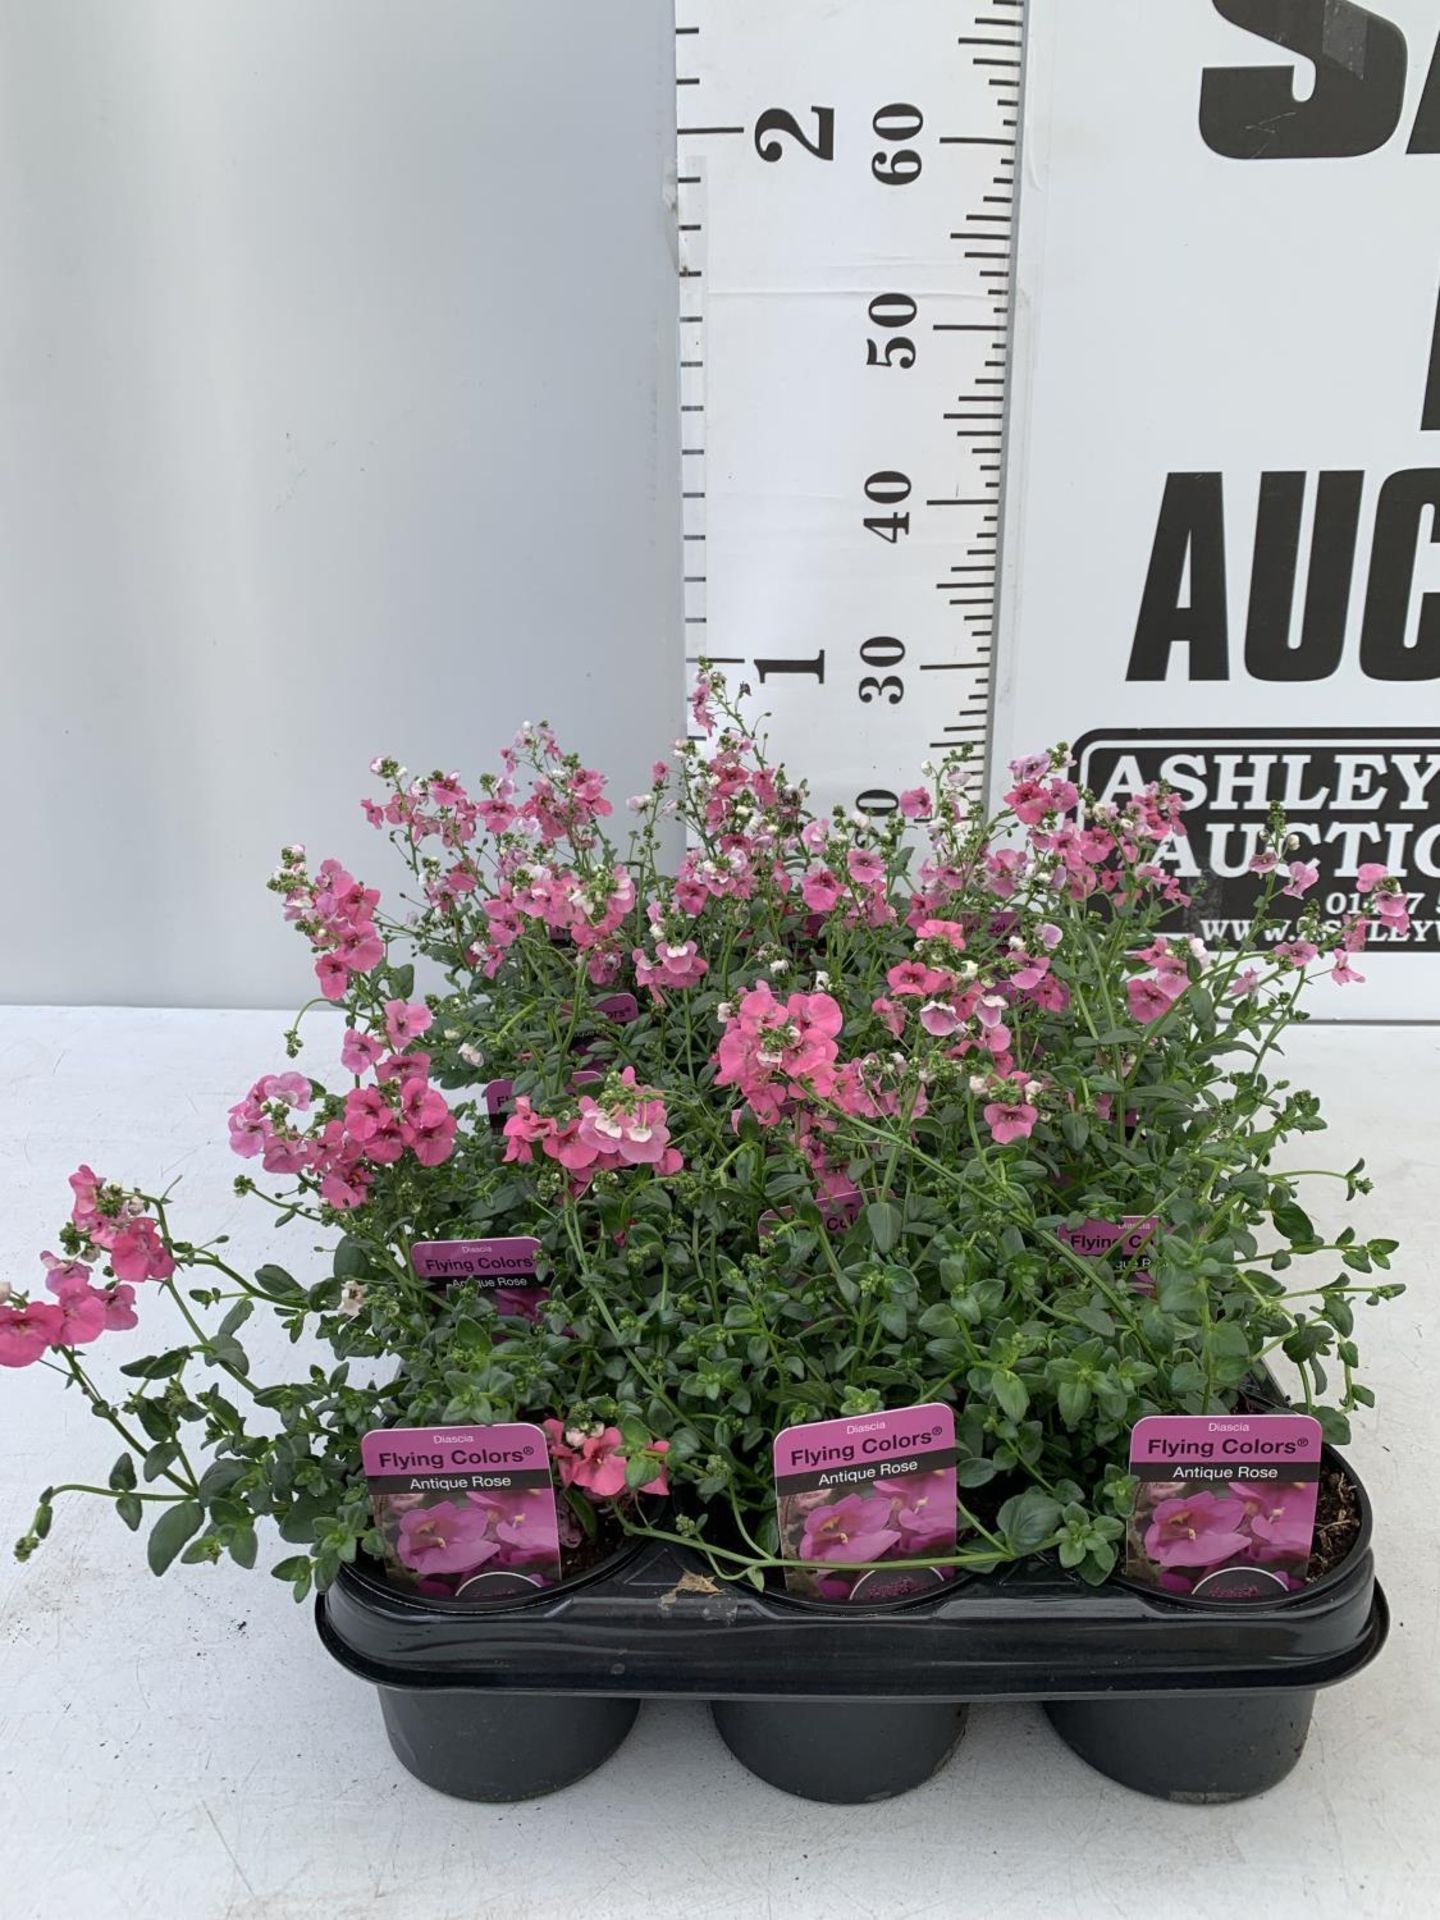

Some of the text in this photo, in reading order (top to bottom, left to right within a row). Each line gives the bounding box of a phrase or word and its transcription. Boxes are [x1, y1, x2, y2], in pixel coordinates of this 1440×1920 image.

[1199, 0, 1440, 159] S
[754, 105, 834, 162] 2
[871, 103, 923, 186] 60
[866, 292, 917, 369] 50
[863, 470, 912, 544] 40
[753, 649, 825, 684] 1
[858, 636, 906, 705] 30
[1099, 754, 1440, 811] ASHLEY
[425, 1259, 475, 1273] Flying
[497, 1276, 528, 1287] Rose
[846, 1421, 886, 1434] Diascia
[1208, 1422, 1249, 1432] Diascia
[433, 1434, 475, 1444] Diascia
[1148, 1438, 1214, 1458] Flying
[379, 1451, 444, 1471] Flying
[791, 1444, 855, 1466] Flying
[410, 1475, 511, 1491] Antique Rose
[818, 1460, 918, 1486] Antique Rose
[1172, 1466, 1278, 1480] Antique Rose
